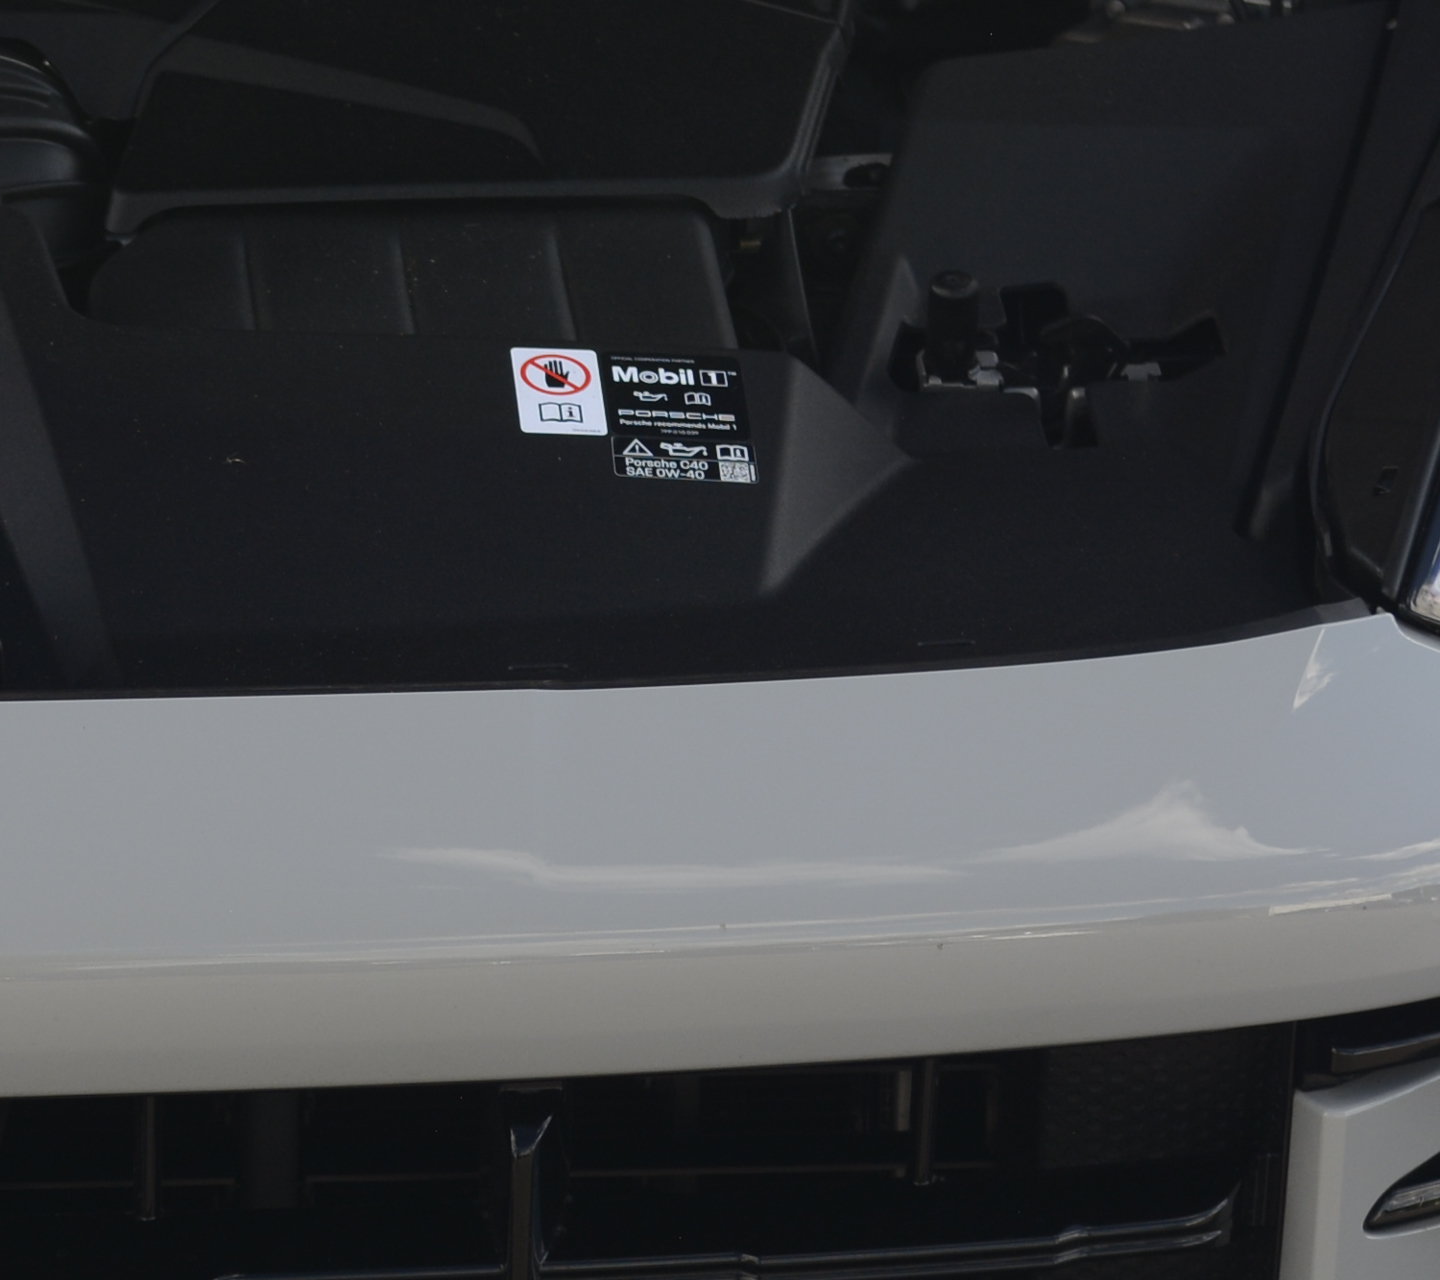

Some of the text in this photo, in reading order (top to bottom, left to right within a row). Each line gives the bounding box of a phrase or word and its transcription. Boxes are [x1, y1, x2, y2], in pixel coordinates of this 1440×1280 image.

[611, 366, 695, 386] Mobil
[618, 409, 736, 422] PORSCHE
[619, 418, 652, 427] Porsche
[654, 420, 706, 429] recommends
[708, 422, 730, 430] Mobil
[625, 457, 708, 470] Porsche C40
[626, 467, 705, 480] SAE 0W-40
